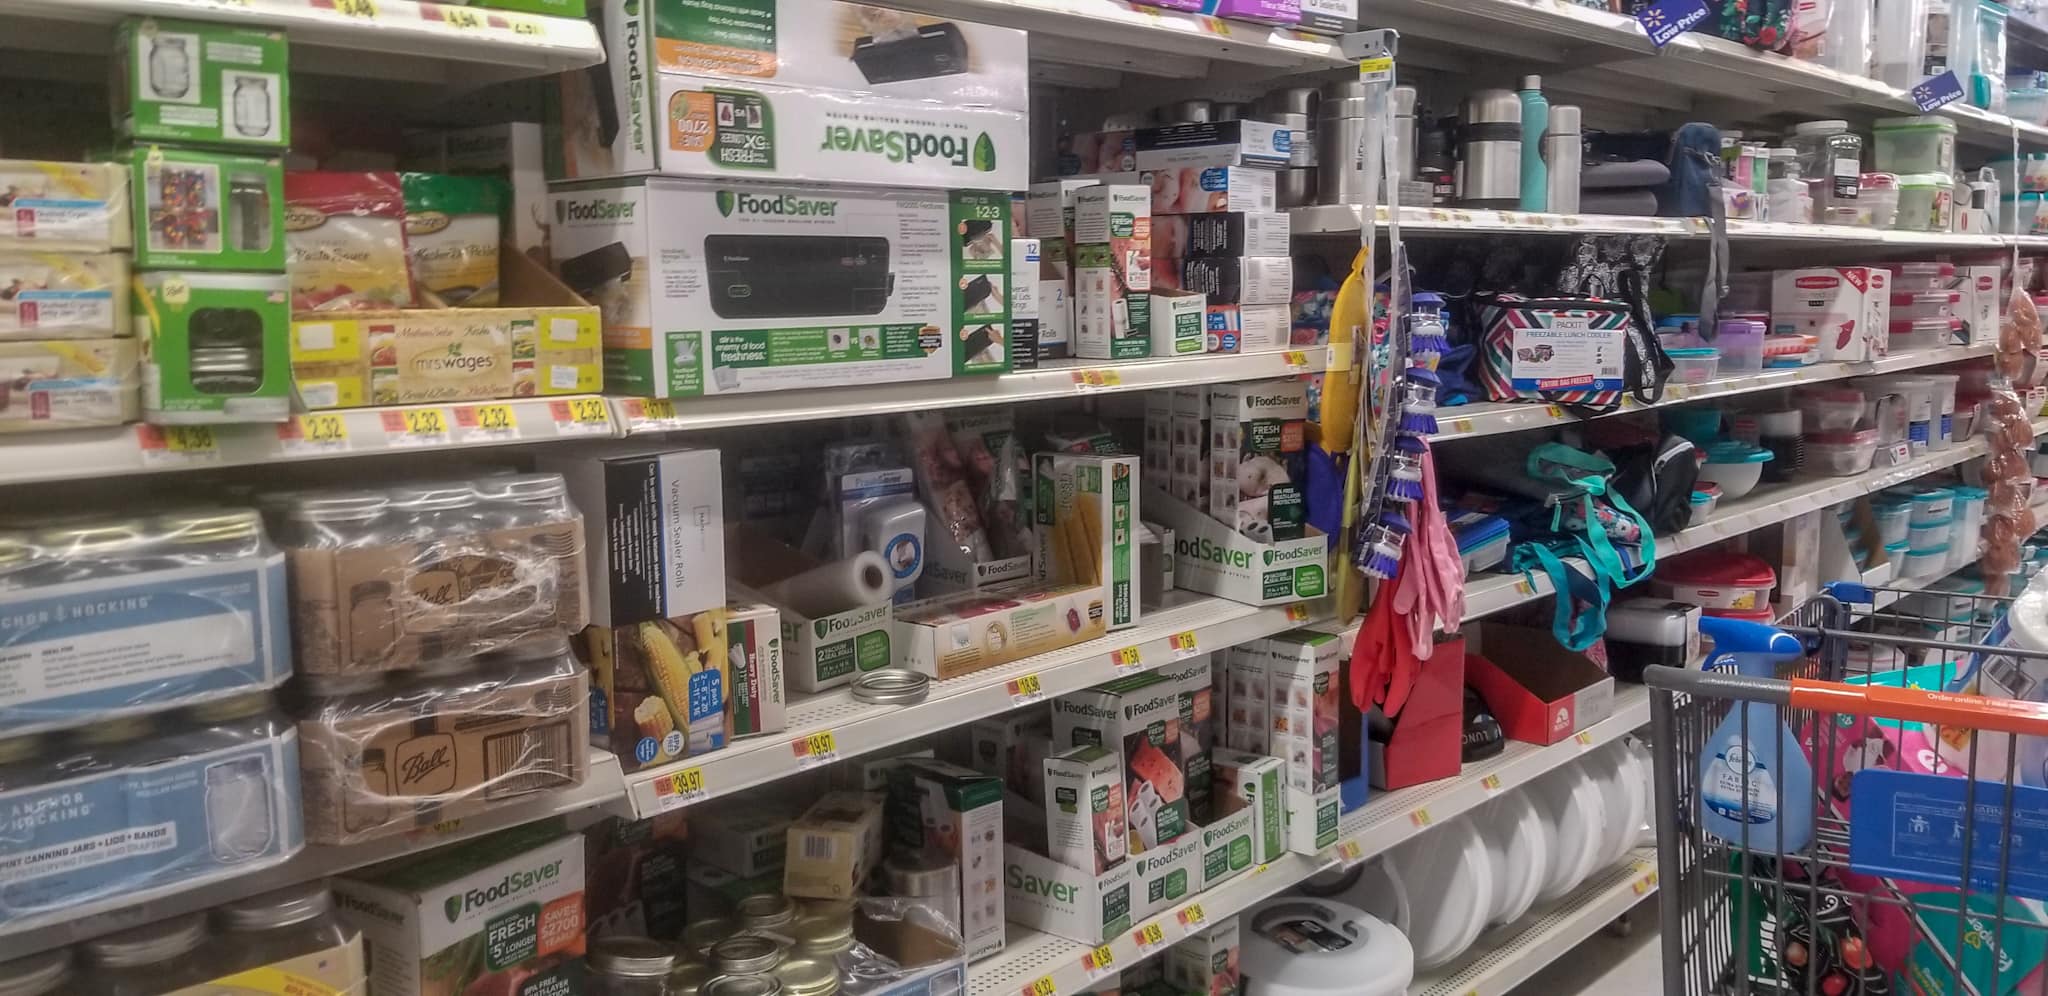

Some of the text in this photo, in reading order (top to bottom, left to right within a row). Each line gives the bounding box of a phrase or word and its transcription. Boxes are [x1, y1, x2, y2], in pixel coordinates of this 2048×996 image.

[1655, 8, 1707, 44] Low Price
[626, 20, 644, 154] FoodSaver
[1923, 98, 1941, 113] Low
[821, 125, 968, 167] FoodSaver
[568, 200, 635, 221] FoodSaver
[737, 194, 838, 218] FoodSaver
[1846, 270, 1864, 287] NEW
[1556, 321, 1582, 329] PACKIT
[415, 355, 494, 373] mrswages
[1254, 394, 1302, 407] FoodSaver
[1252, 425, 1281, 435] FRESH
[671, 479, 685, 589] Vacuum Sealer Rolls
[1273, 546, 1324, 562] FoodSaver
[72, 597, 149, 618] HOCKING
[829, 604, 889, 631] FooSaver
[749, 653, 759, 699] Heavy Duty
[769, 648, 781, 705] FoodSaver
[1133, 693, 1177, 715] FoodSaver
[1927, 691, 1953, 703] Order
[1063, 701, 1118, 720] FoodSaver
[402, 747, 451, 784] Ball
[1721, 773, 1759, 788] FABC
[1212, 816, 1251, 840] FoodSaver
[24, 845, 69, 866] CANNING
[70, 841, 96, 856] JARS
[1147, 841, 1198, 871] FoodSaver
[464, 859, 563, 913] FoodSaver
[488, 914, 536, 946] FRESH
[505, 934, 537, 956] LONGER
